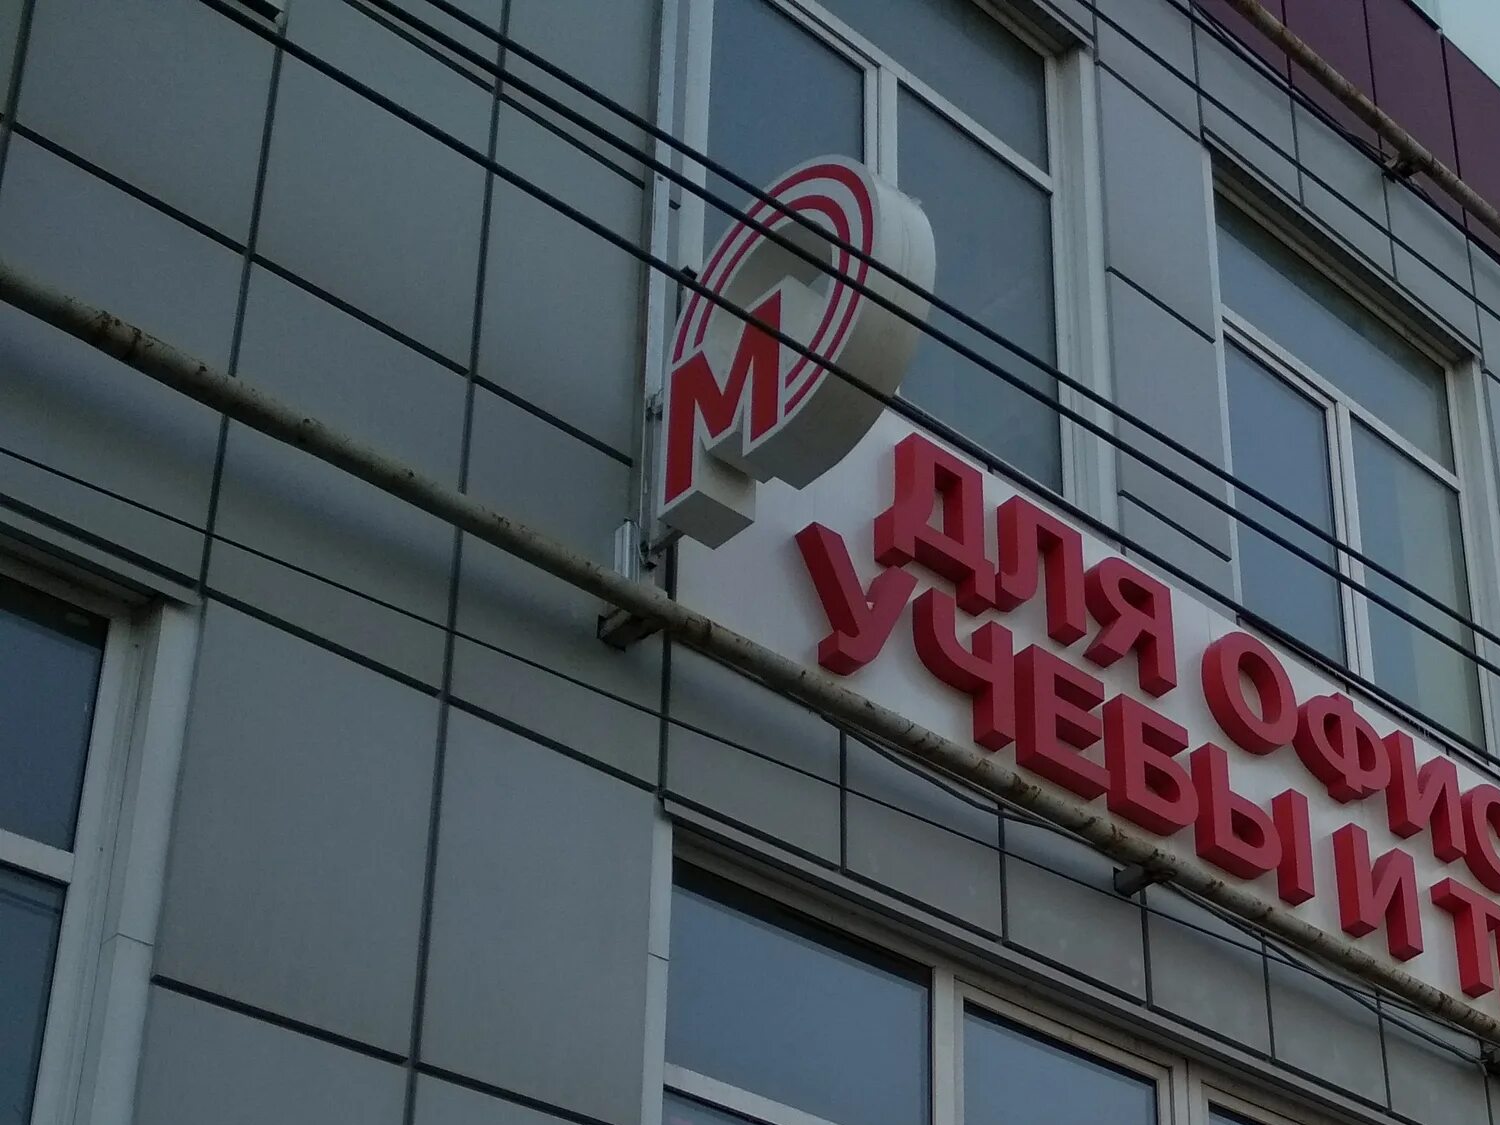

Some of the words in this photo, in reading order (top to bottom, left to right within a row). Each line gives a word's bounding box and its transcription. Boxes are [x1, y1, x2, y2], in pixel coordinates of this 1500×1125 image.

[874, 431, 1176, 697] ДЛЯ
[795, 522, 1316, 907] УЧЕБЫ
[1332, 823, 1424, 961] И
